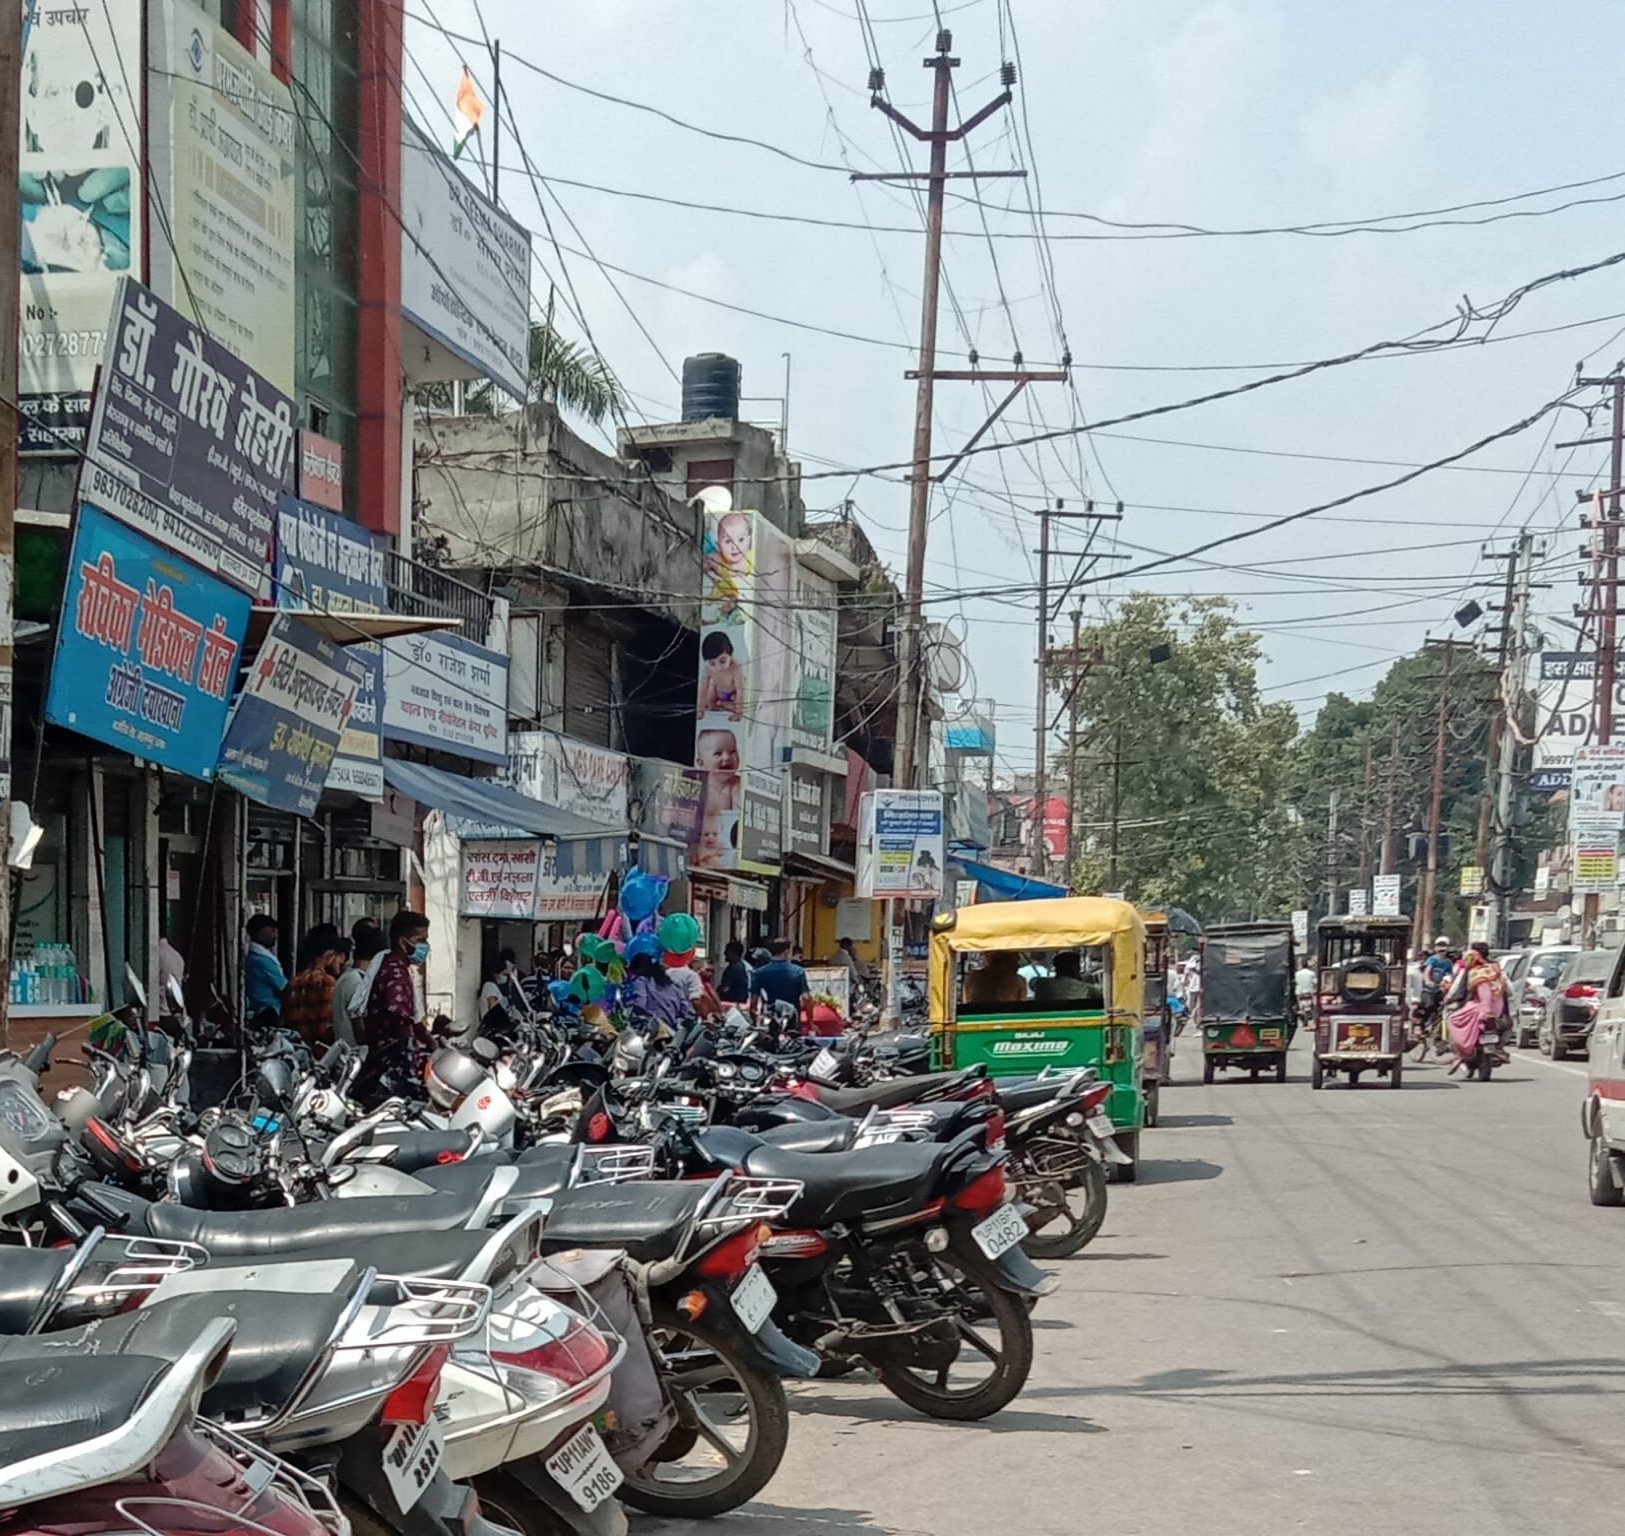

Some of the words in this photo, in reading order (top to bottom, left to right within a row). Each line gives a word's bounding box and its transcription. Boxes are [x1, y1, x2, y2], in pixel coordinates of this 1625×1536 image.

[45, 8, 91, 27] उपचार
[26, 304, 45, 321] No
[118, 291, 158, 393] डॉ.
[171, 329, 236, 441] गौरव
[438, 649, 467, 676] राजेश
[470, 662, 492, 687] शर्मा
[987, 1220, 1026, 1255] 0482
[582, 1466, 617, 1505] 9186
